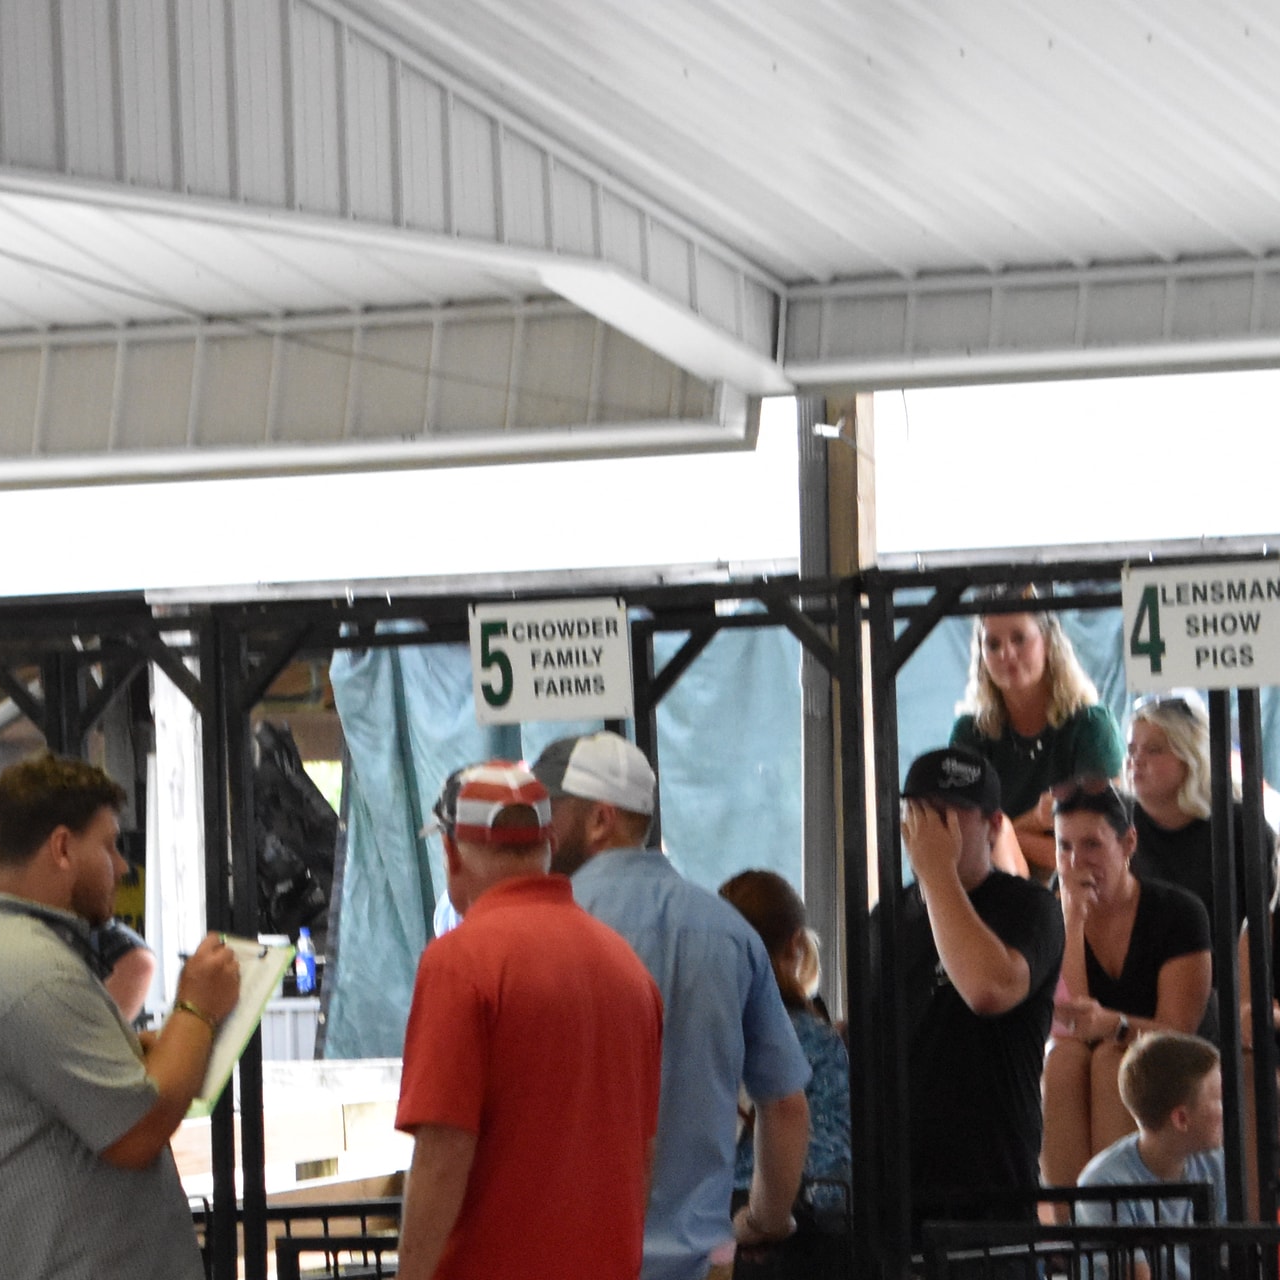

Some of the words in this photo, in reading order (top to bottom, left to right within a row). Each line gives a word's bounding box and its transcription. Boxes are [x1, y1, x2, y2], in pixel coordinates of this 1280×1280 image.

[511, 615, 619, 642] CROWDER
[1130, 583, 1166, 675] 4
[1185, 611, 1261, 637] SHOW
[480, 619, 514, 708] 5
[531, 645, 603, 670] FAMILY
[1195, 643, 1254, 669] PIGS
[534, 674, 606, 698] FARMS
